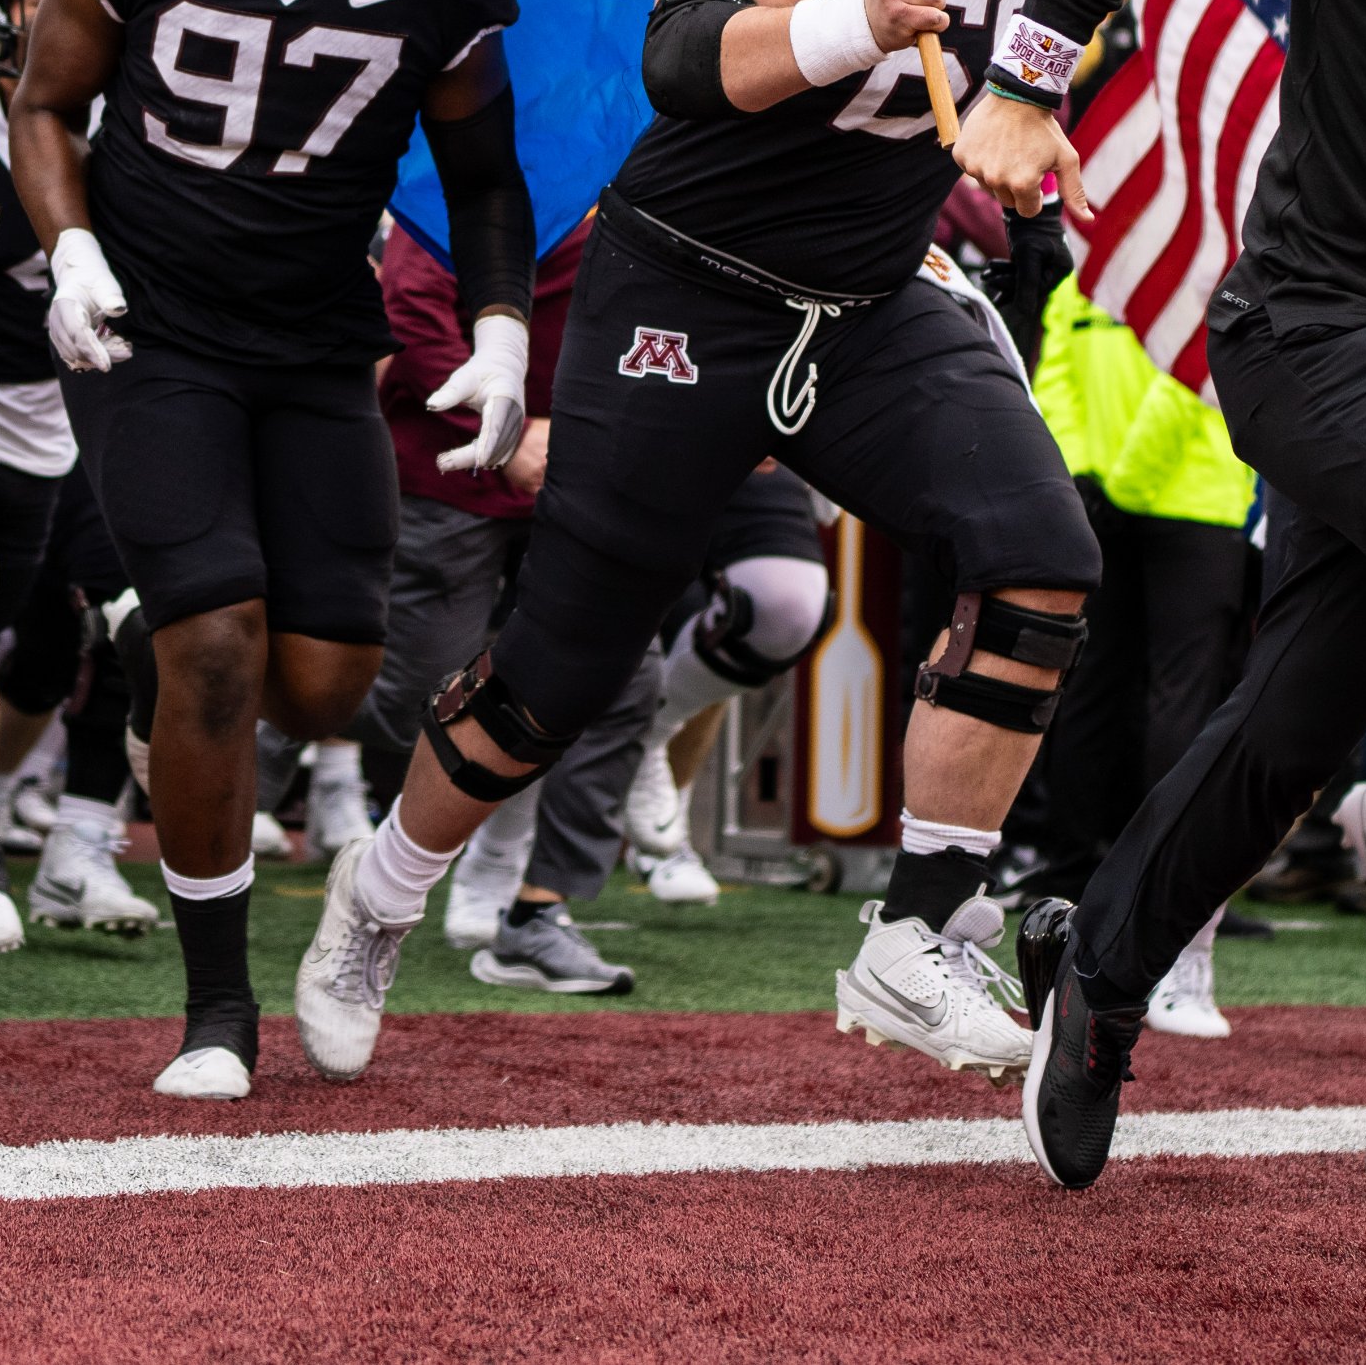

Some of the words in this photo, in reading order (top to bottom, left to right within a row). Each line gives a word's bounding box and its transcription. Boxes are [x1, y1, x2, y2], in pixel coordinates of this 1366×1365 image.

[1010, 37, 1035, 62] BOAT
[1031, 53, 1048, 68] THE
[1044, 61, 1071, 76] ROW
[619, 325, 698, 385] M
